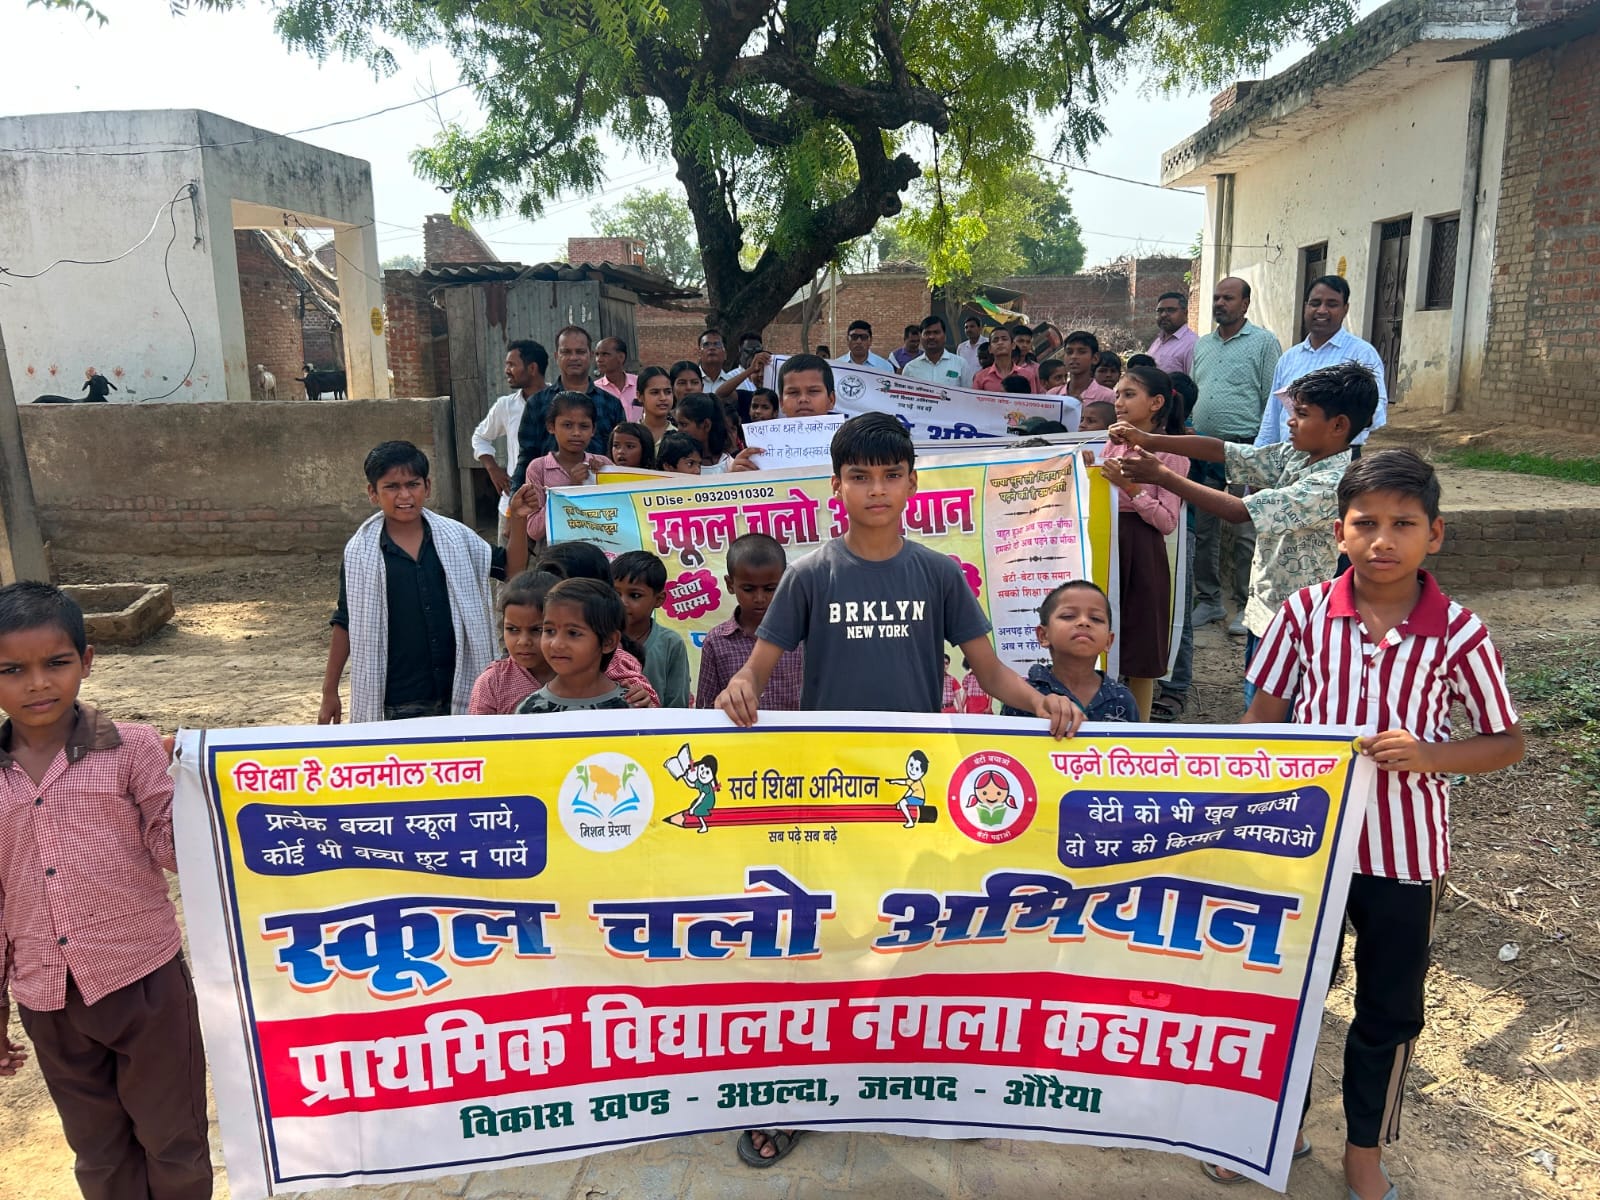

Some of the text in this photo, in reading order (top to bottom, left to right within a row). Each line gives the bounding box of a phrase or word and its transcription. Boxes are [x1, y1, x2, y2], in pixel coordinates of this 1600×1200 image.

[747, 423, 768, 437] शिक्षा
[769, 425, 780, 433] का
[783, 424, 796, 434] धन
[805, 420, 823, 433] सबसे
[785, 444, 801, 458] होता
[643, 496, 652, 507] U
[656, 494, 683, 506] Dise
[694, 487, 775, 503] 09320910302
[648, 505, 738, 566] स्कूल
[742, 489, 820, 545] चलो
[1037, 571, 1049, 582] एक
[1051, 571, 1071, 580] समान
[670, 578, 703, 599] प्रवेश
[997, 587, 1019, 598] सबको
[1022, 586, 1041, 598] शिक्षा
[829, 600, 926, 623] BRKLYN
[847, 624, 909, 640] NEW YORK
[998, 627, 1022, 637] अनपढ़
[1001, 642, 1015, 651] अब
[234, 757, 483, 791] शिक्षा है अनमोल रतन
[1051, 747, 1338, 780] पढ़ने लिखने का करो जतन
[728, 767, 880, 800] सर्व शिक्षा अभियान
[1088, 792, 1300, 825] बेटी को भी खूब पढ़ाओ
[265, 803, 519, 840] प्रत्येक बच्चा स्कूल जाये,
[580, 821, 631, 838] मिशन प्रेरणा
[768, 830, 784, 843] सब
[804, 830, 820, 843] सब
[1066, 825, 1316, 857] दो घर की किस्मत चमकाओ
[261, 838, 305, 866] कोई
[317, 839, 342, 859] भी
[352, 846, 404, 864] बच्चा
[414, 851, 448, 871] छूट
[460, 850, 478, 868] न
[262, 867, 1300, 998] स्कूल चलो अभियान
[289, 1009, 571, 1107] प्राथमिक
[584, 995, 841, 1069] विद्यालय
[849, 997, 1031, 1052] नगला
[460, 1101, 574, 1138] विकास
[590, 1089, 671, 1122] खण्ड
[717, 1078, 839, 1108] अछल्दा,
[858, 1076, 958, 1100] जनपद
[1003, 1074, 1103, 1113] औरैया
